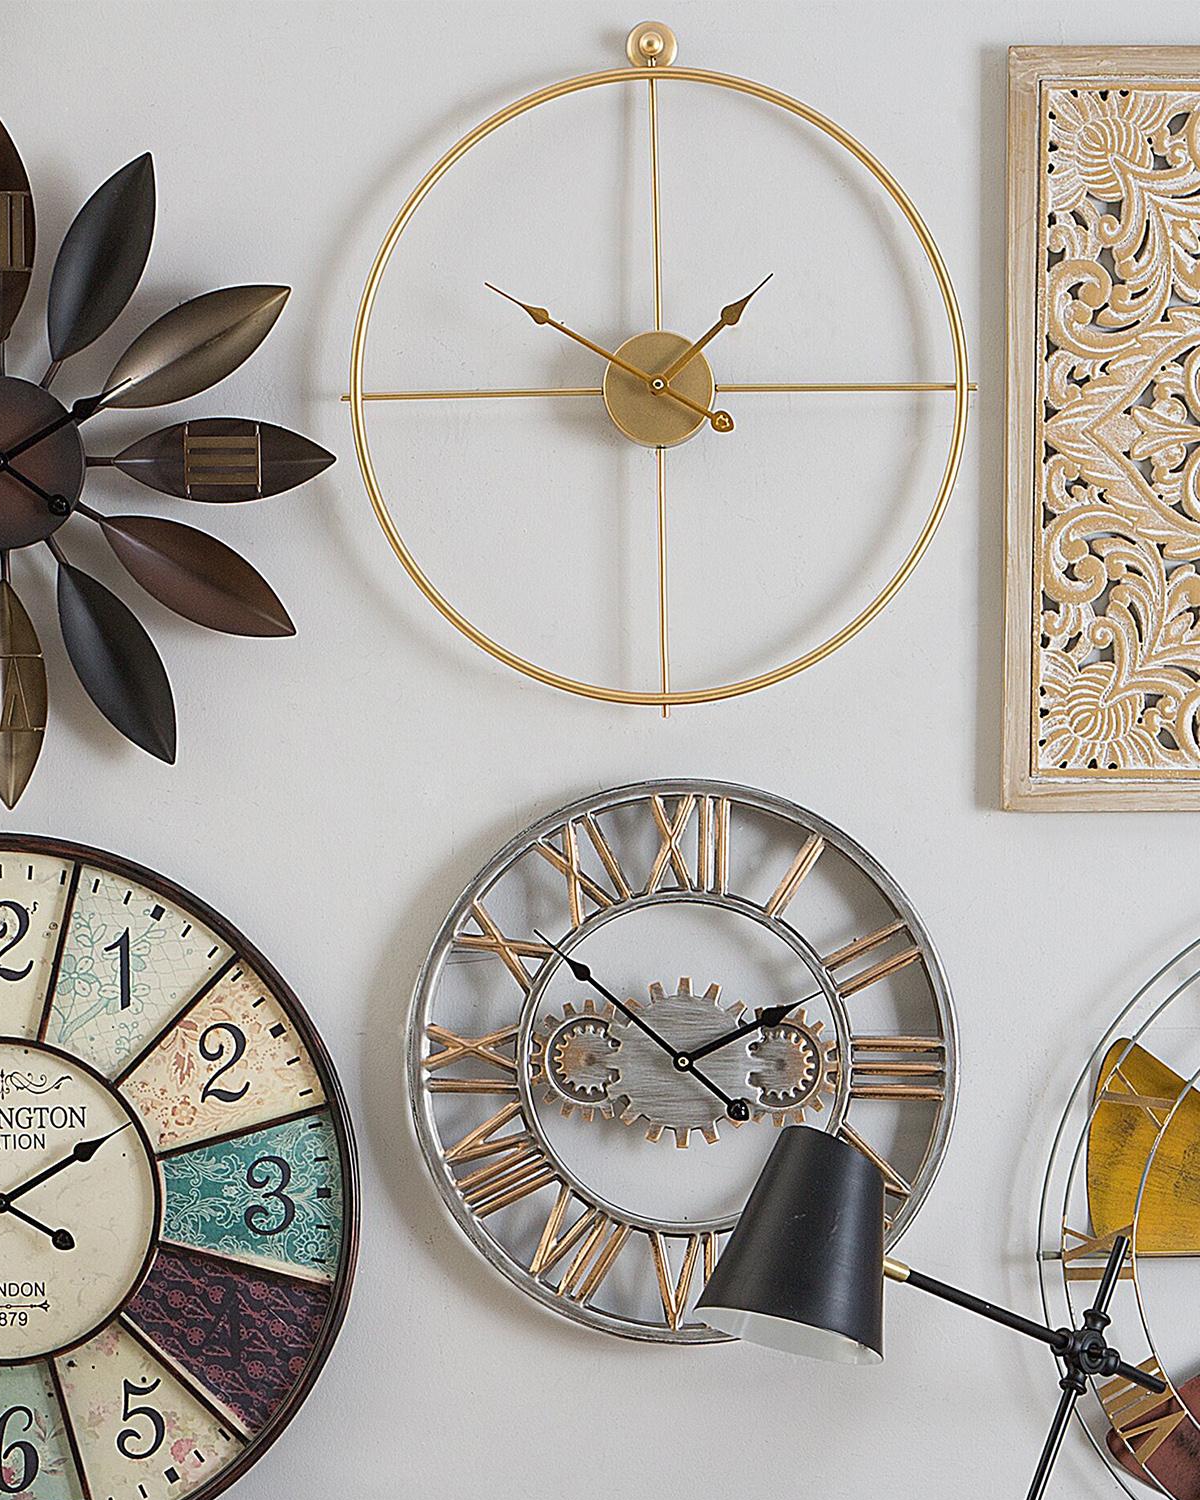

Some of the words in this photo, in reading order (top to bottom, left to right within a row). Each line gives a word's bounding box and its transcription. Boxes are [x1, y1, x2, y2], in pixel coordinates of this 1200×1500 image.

[645, 793, 733, 898] XII
[103, 926, 133, 1011] 1
[198, 1022, 251, 1104] 2
[246, 1155, 295, 1237] 3
[116, 1376, 166, 1460] 5
